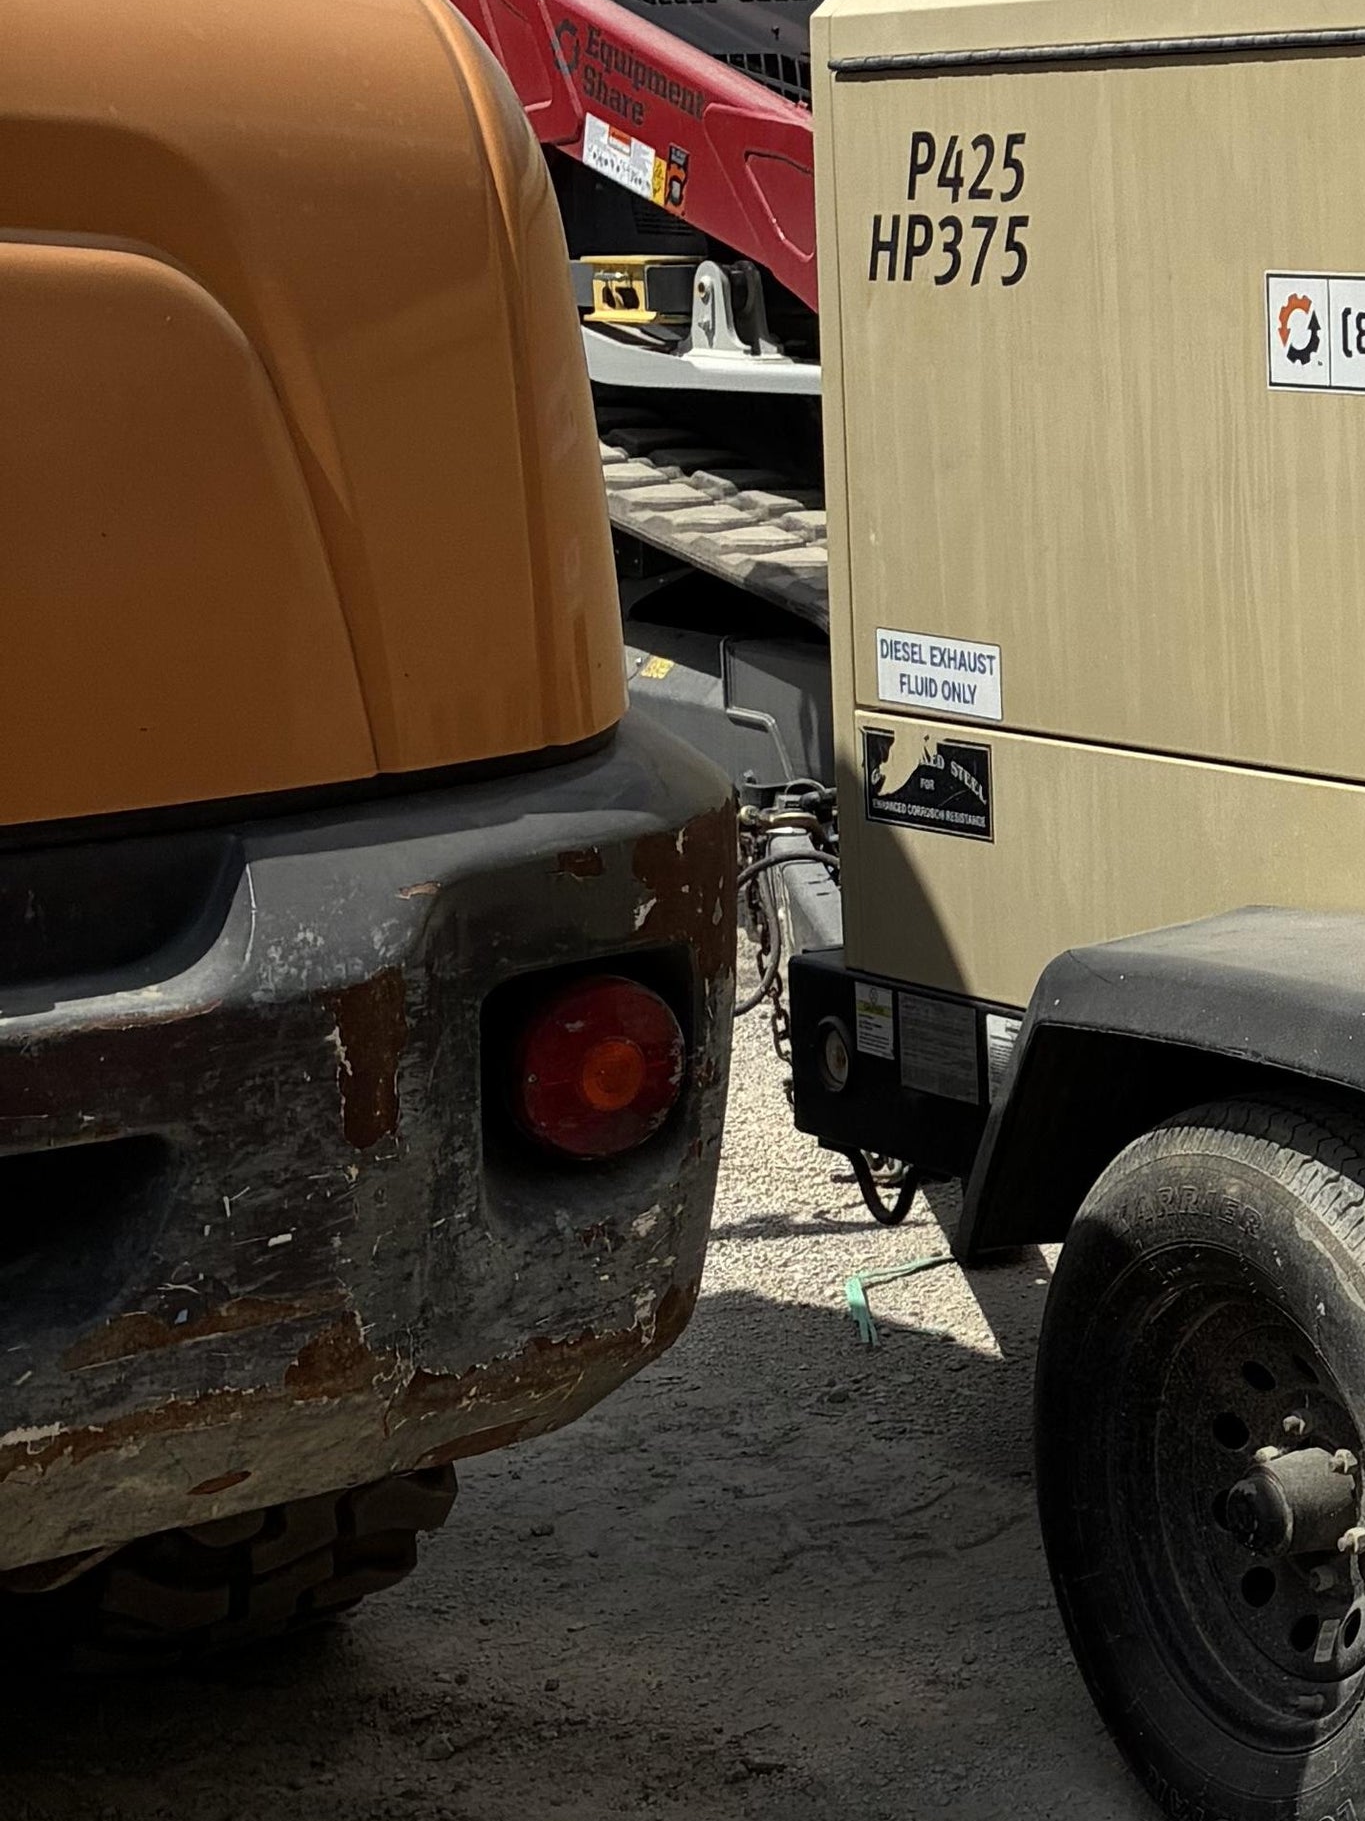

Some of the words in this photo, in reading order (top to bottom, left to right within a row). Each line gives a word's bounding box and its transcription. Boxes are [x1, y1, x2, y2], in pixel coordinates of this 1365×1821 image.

[581, 63, 646, 126] Share
[583, 25, 706, 122] Equipment
[906, 130, 1027, 205] P425
[867, 213, 1030, 287] HP375
[880, 638, 928, 666] DIESEL
[929, 645, 997, 677] EXHAUST
[899, 672, 938, 699] FLUID
[941, 679, 977, 706] ONLY
[919, 777, 936, 791] FOR
[950, 760, 988, 806] STEEL
